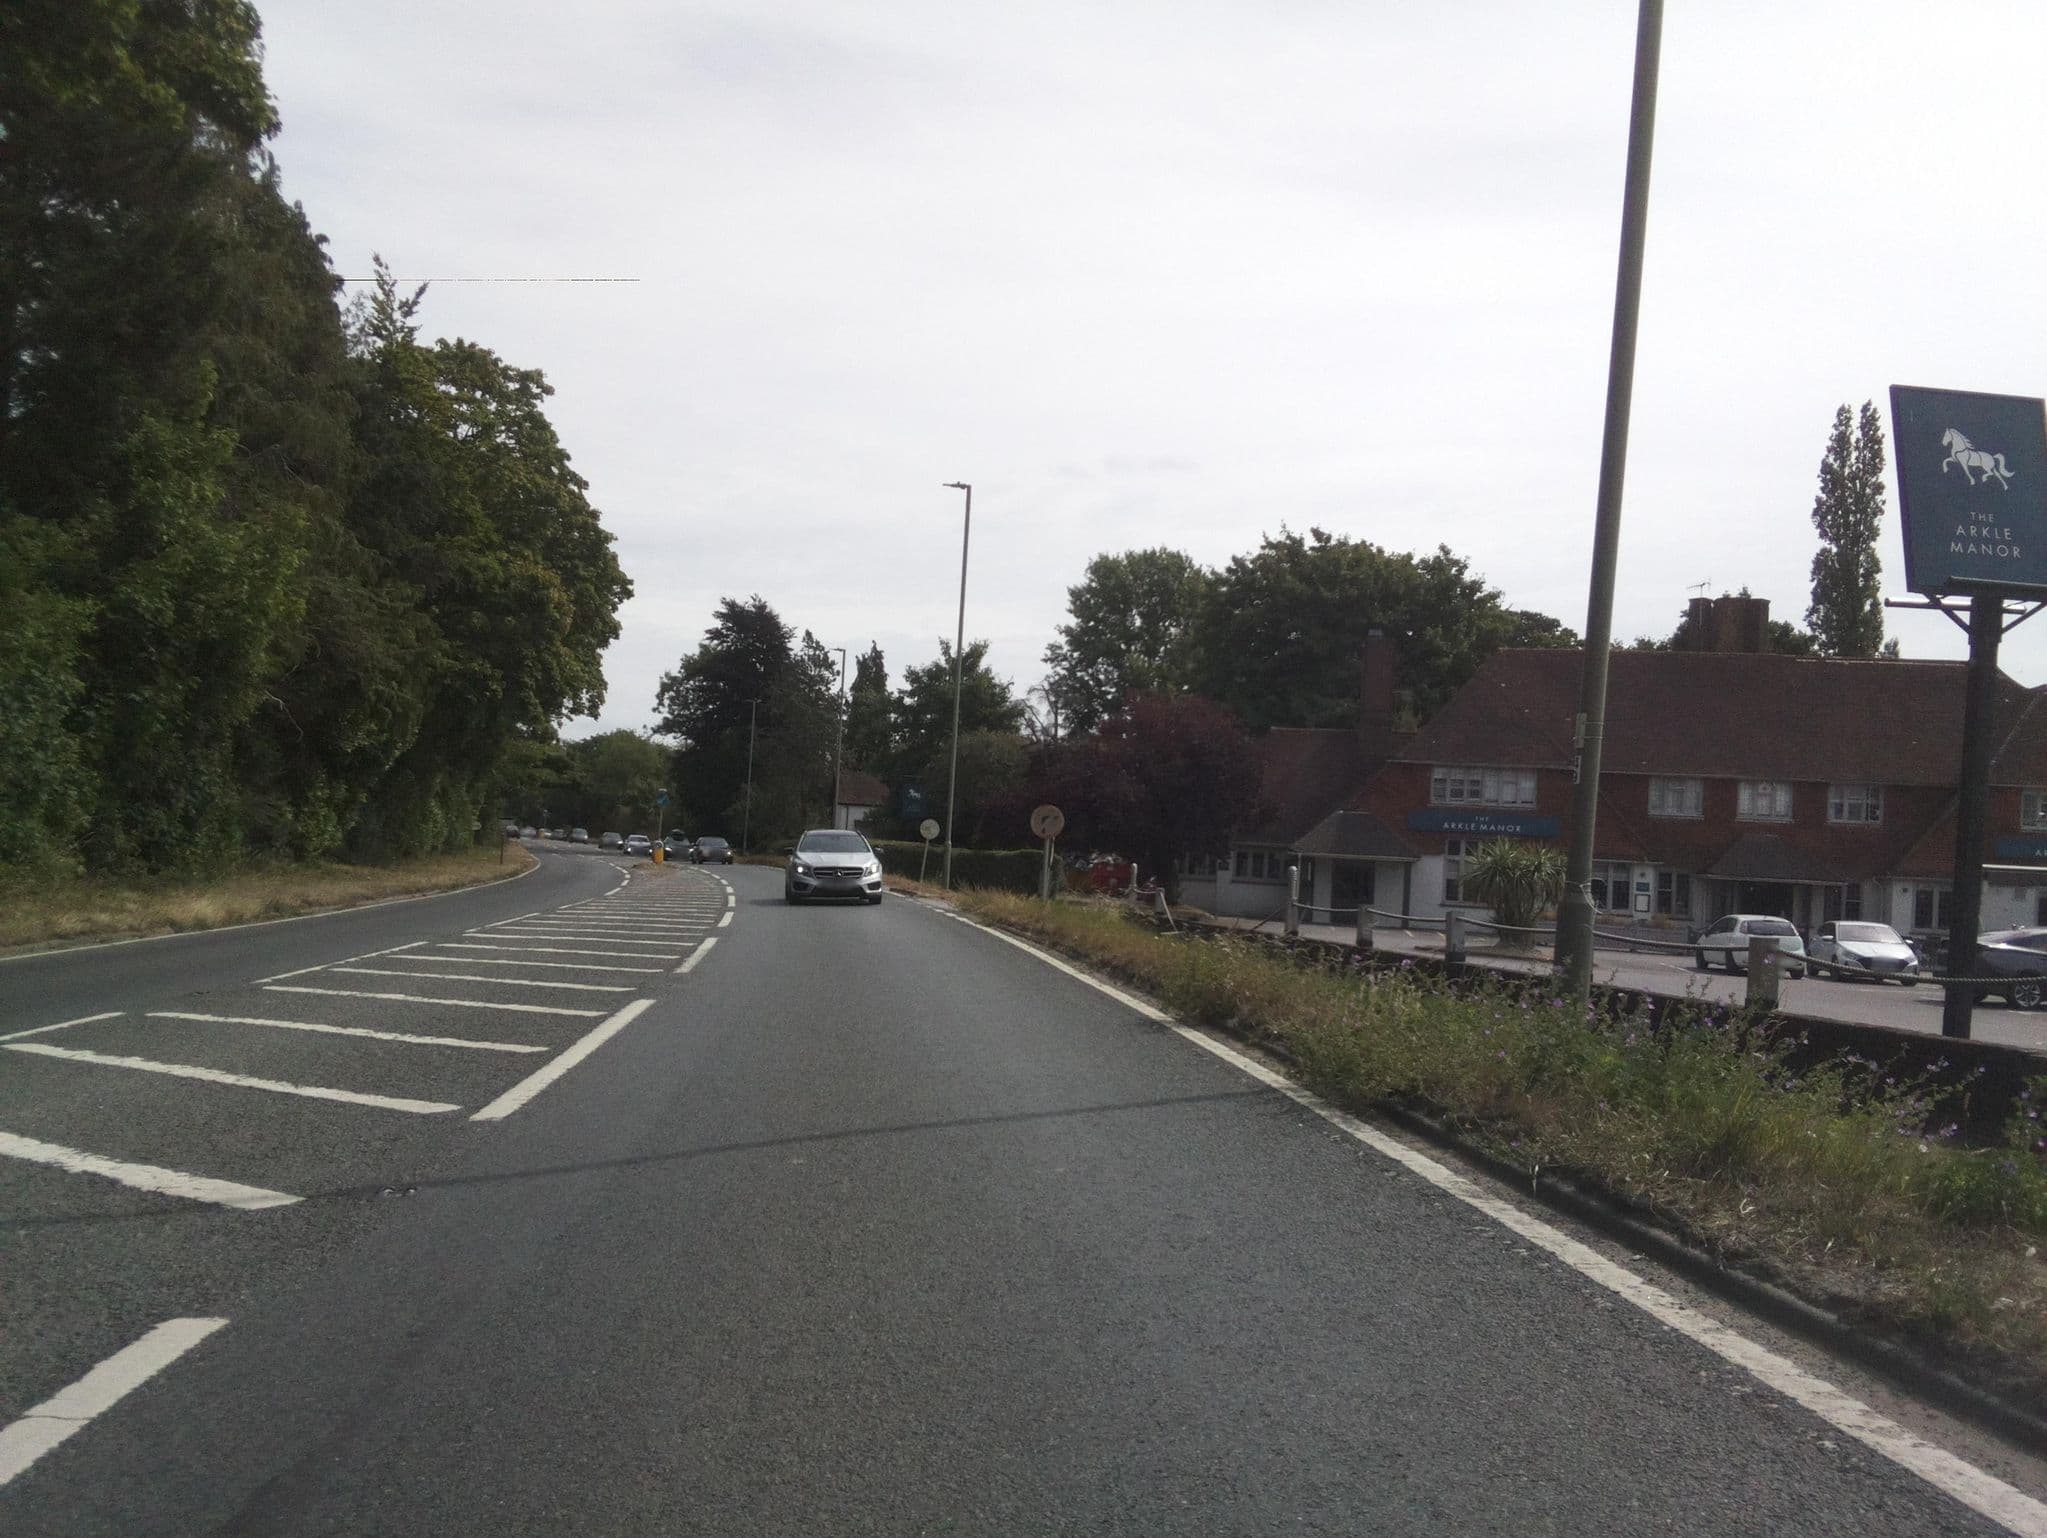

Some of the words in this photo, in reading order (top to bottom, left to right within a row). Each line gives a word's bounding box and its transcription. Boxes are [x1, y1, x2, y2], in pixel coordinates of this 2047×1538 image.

[1969, 511, 1995, 522] THE
[1956, 525, 2013, 540] ARKLE
[1950, 541, 2022, 558] MANOR
[1443, 822, 1476, 831] ARKLE
[1479, 823, 1521, 832] MANOR
